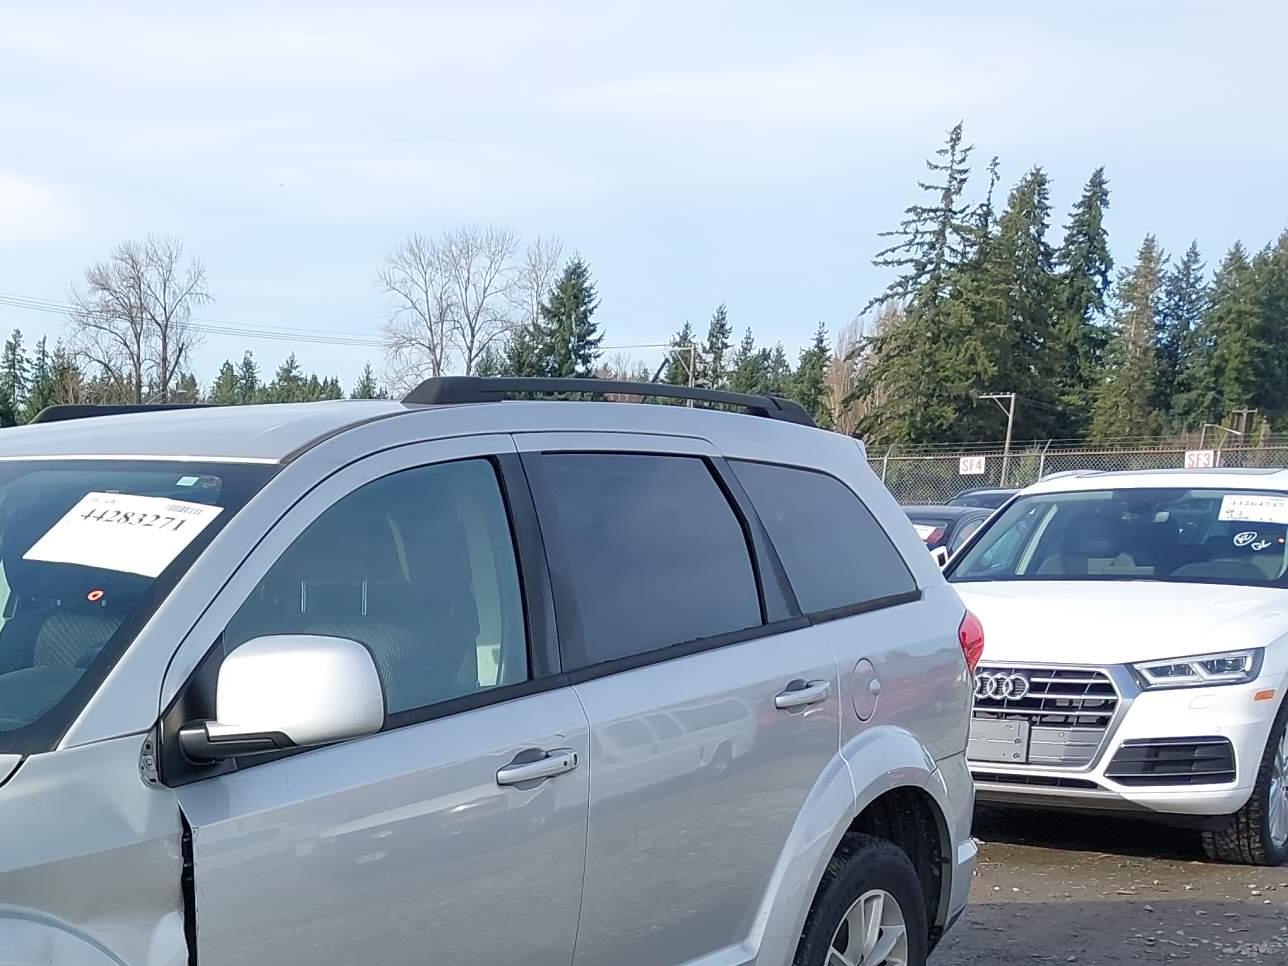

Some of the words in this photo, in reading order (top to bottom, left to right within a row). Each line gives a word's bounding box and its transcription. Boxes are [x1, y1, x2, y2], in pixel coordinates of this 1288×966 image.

[962, 459, 983, 472] SF4
[1188, 452, 1211, 468] SF3
[80, 508, 186, 531] 44283271
